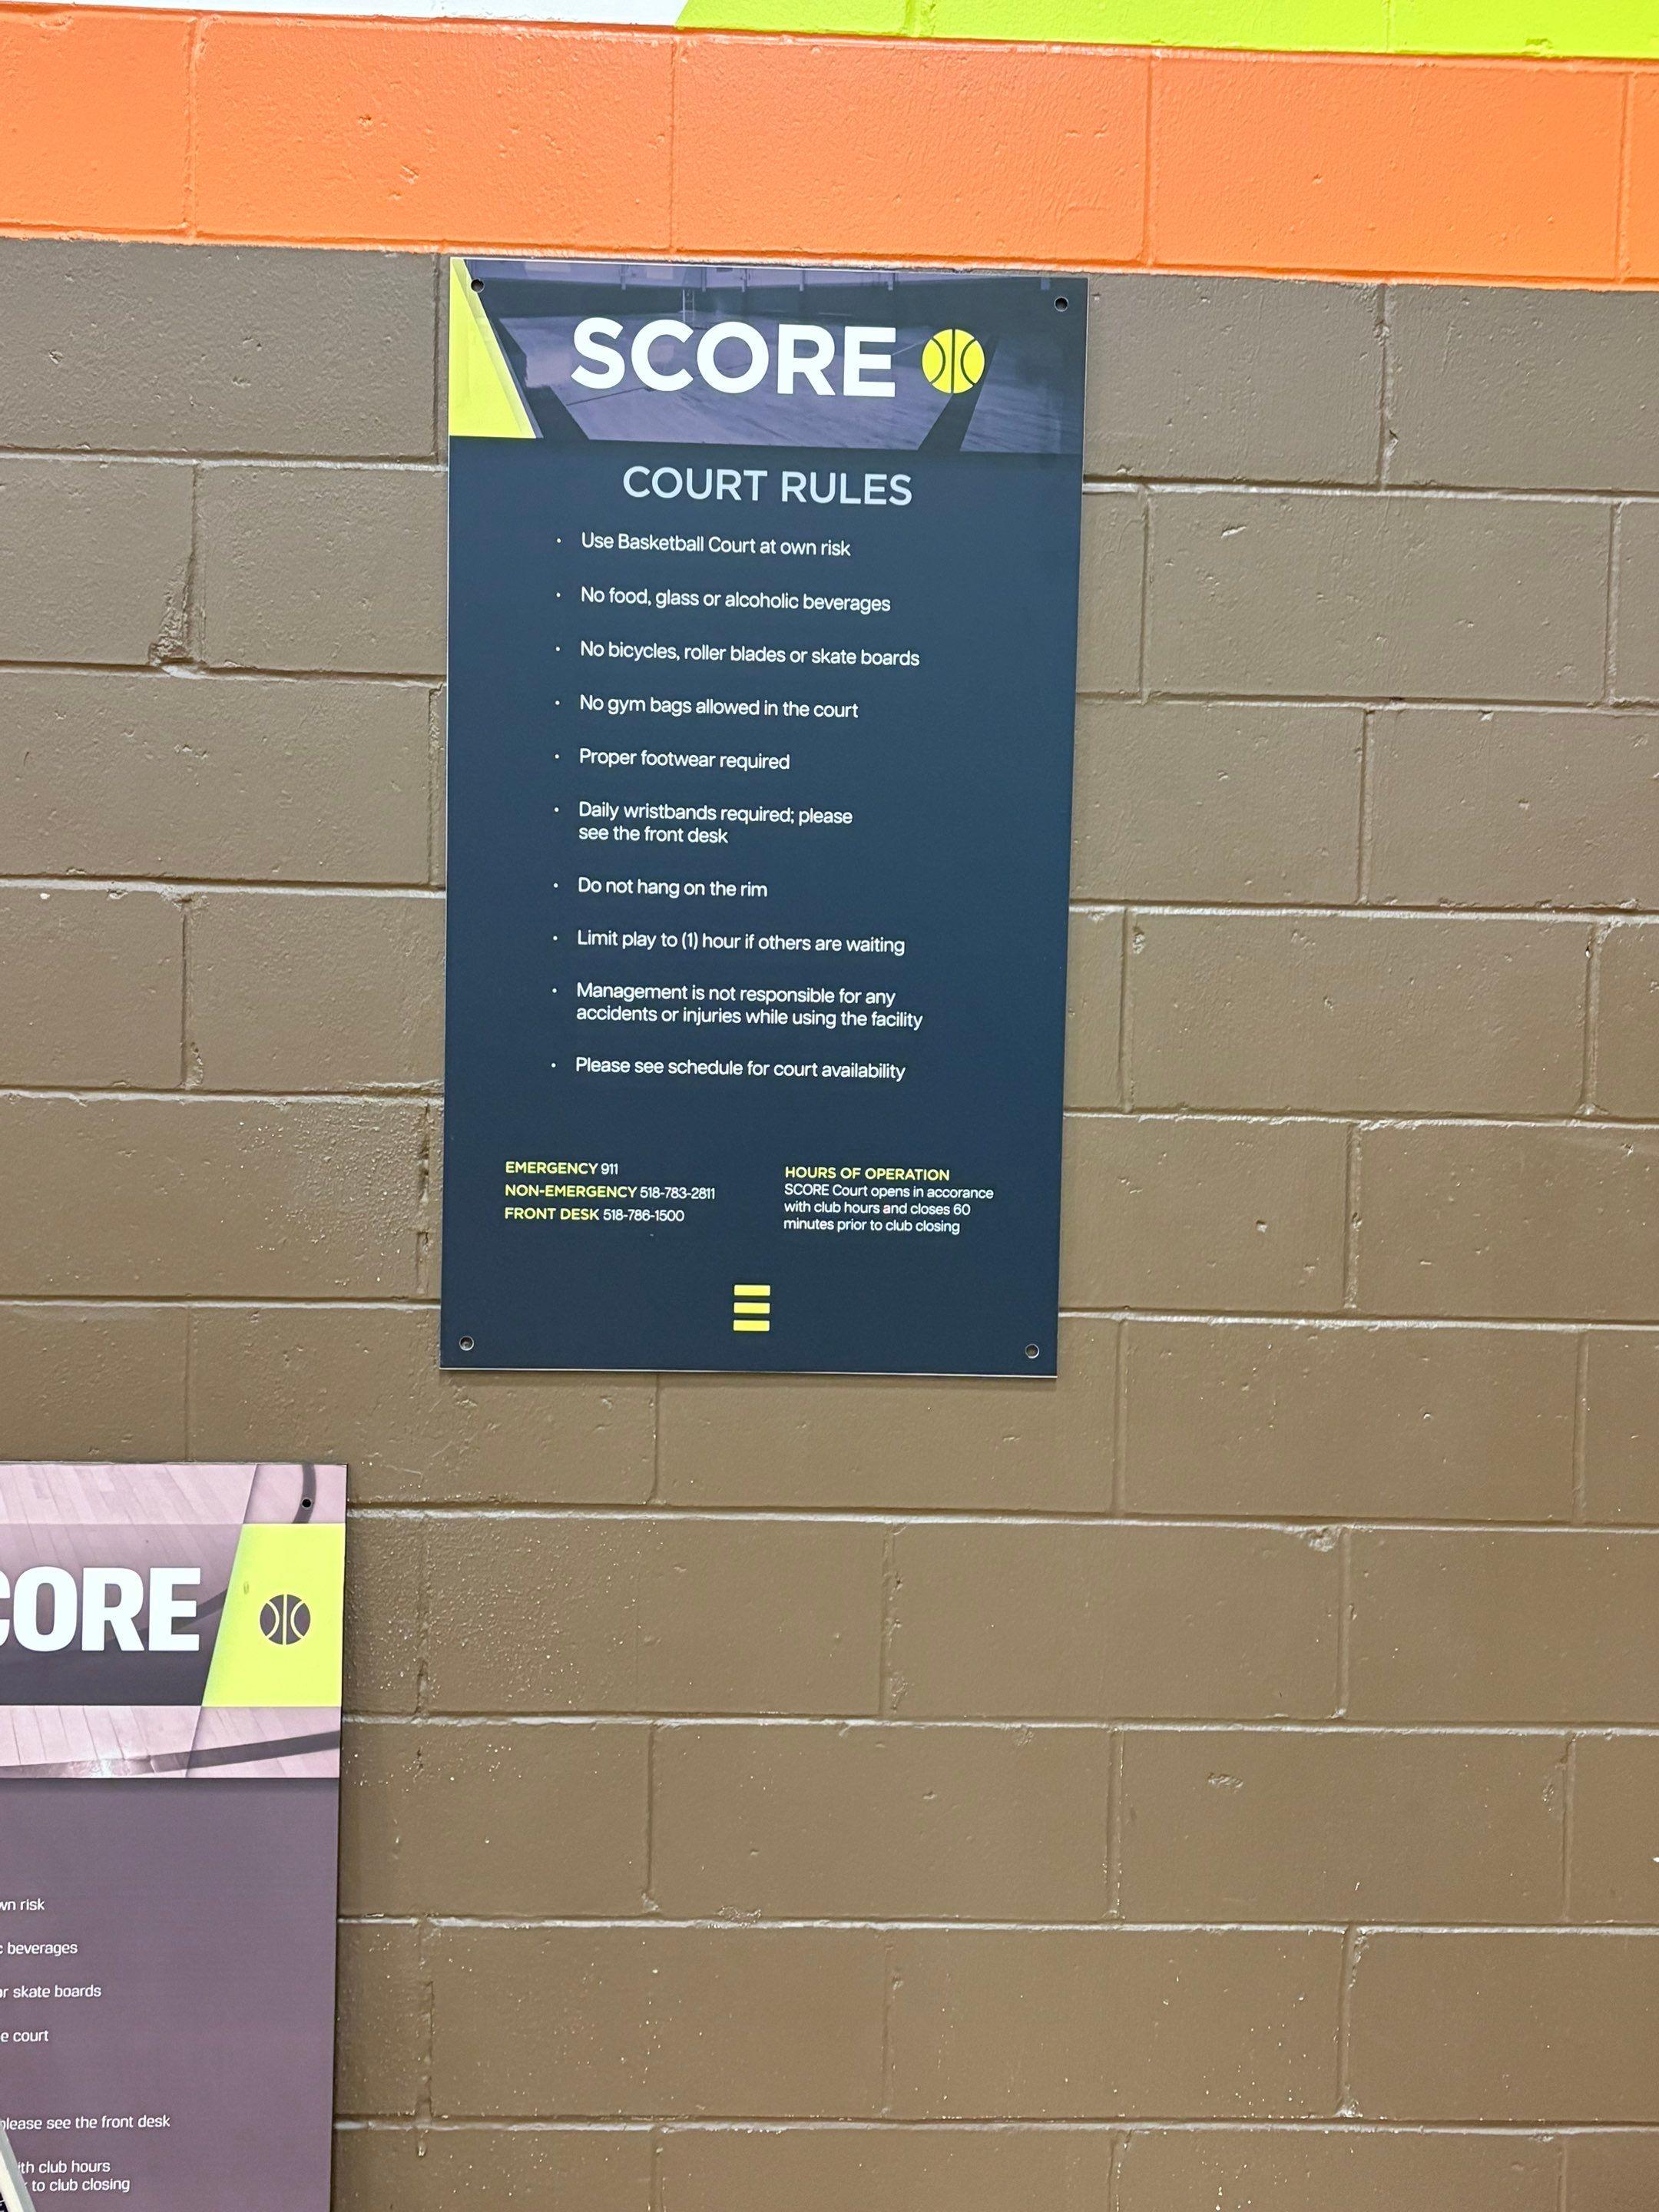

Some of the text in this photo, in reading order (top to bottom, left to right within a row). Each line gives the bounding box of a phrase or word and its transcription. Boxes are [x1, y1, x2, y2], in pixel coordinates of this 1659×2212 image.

[571, 317, 896, 397] SCORE
[623, 465, 912, 506] COURT RULES
[581, 531, 851, 557] Use Basketball Court at own risk
[581, 586, 891, 615] No food, glass or alcoholic beverages
[581, 640, 920, 667] No bicycles, roller blades or skate boards
[580, 694, 859, 718] No gym bags allowed in the court
[580, 747, 790, 772] Proper footwear required
[579, 800, 853, 826] Daily wristbands required; please
[578, 825, 729, 844] see the front desk
[578, 876, 768, 899] Do not hang on the rim
[578, 929, 906, 957] Limit play to (1) hour if others are waiting
[577, 982, 896, 1008] Management is not responsible for any
[576, 1005, 923, 1031] accidents or injuries while using the facility
[576, 1056, 906, 1082] Please see schedule for court availability
[505, 1161, 618, 1175] EMERGENCY 911
[785, 1166, 950, 1181] HOURS OF OPERATION
[505, 1184, 715, 1200] NON-EMERGENCY 518-783-2811
[784, 1183, 994, 1200] SCORE Court opens in accorance
[505, 1207, 685, 1222] FRONT DESK 518-786-1500
[783, 1200, 971, 1216] with club hours and closes 60
[783, 1217, 960, 1236] minutes prior to club closing
[0, 1566, 200, 1651] ORE
[20, 1898, 45, 1911] risk
[7, 1942, 78, 1957] beverages
[13, 1985, 51, 1998] skate
[54, 1984, 102, 1998] boards
[12, 2030, 49, 2042] court
[46, 2118, 71, 2130] see
[75, 2116, 98, 2129] the
[101, 2115, 134, 2128] front
[137, 2114, 171, 2128] desk
[38, 2160, 68, 2174] club
[71, 2160, 111, 2173] hours
[31, 2180, 45, 2192] to
[49, 2177, 78, 2192] club
[81, 2177, 131, 2193] closing
